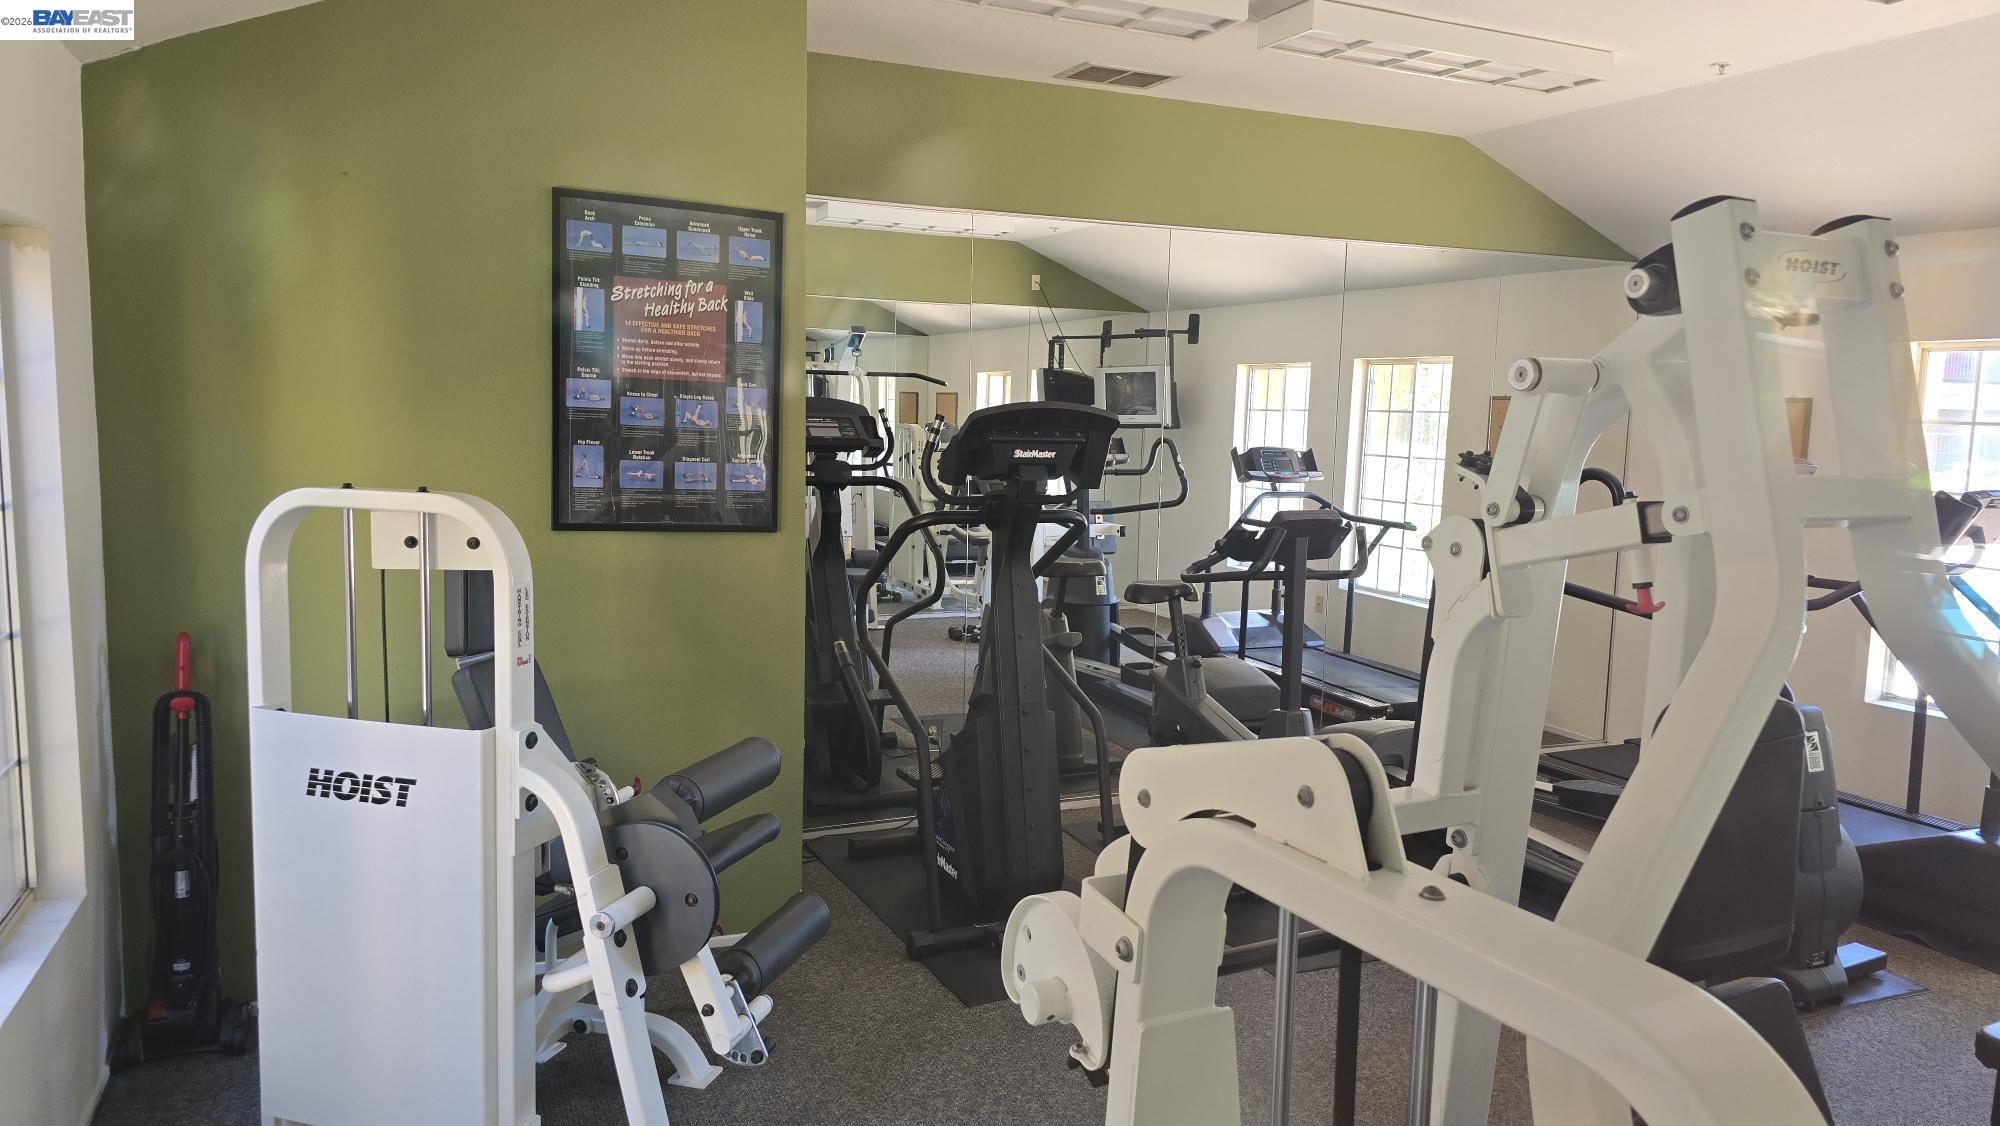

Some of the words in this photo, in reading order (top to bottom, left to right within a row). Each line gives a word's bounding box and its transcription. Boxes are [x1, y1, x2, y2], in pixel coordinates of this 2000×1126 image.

[1784, 256, 1843, 276] HOIST
[610, 281, 682, 302] Stretching
[684, 279, 704, 299] for
[705, 280, 714, 293] a
[644, 298, 695, 318] Healthy
[698, 295, 729, 312] Back
[631, 320, 659, 328] EFFECTIVE
[686, 324, 717, 332] STRETCHES
[657, 328, 686, 336] HEALTHIER
[1012, 448, 1057, 459] StairMaster
[305, 766, 418, 808] HOIST
